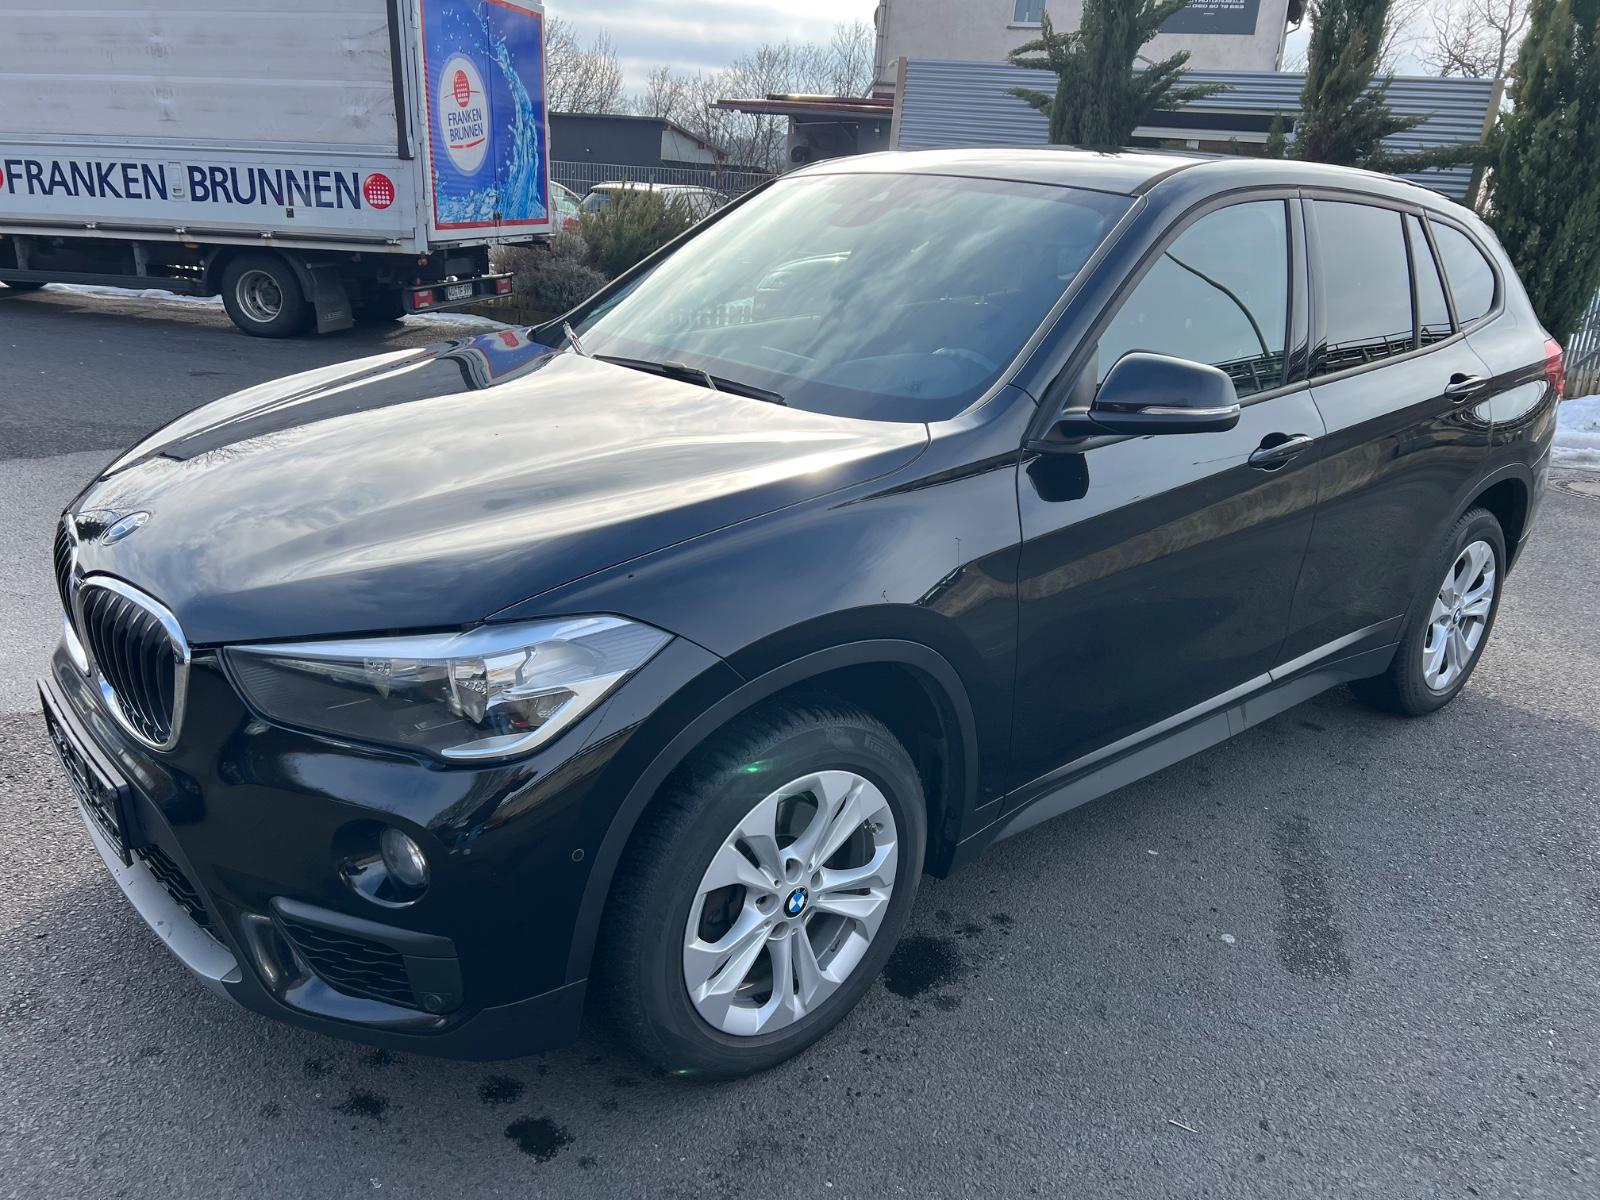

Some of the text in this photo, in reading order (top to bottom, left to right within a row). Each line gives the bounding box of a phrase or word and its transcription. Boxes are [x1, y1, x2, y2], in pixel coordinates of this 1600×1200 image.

[448, 108, 482, 126] FRANKEN
[449, 123, 484, 142] BRUNNEN
[4, 159, 362, 210] FRANKEN BRUNNEN
